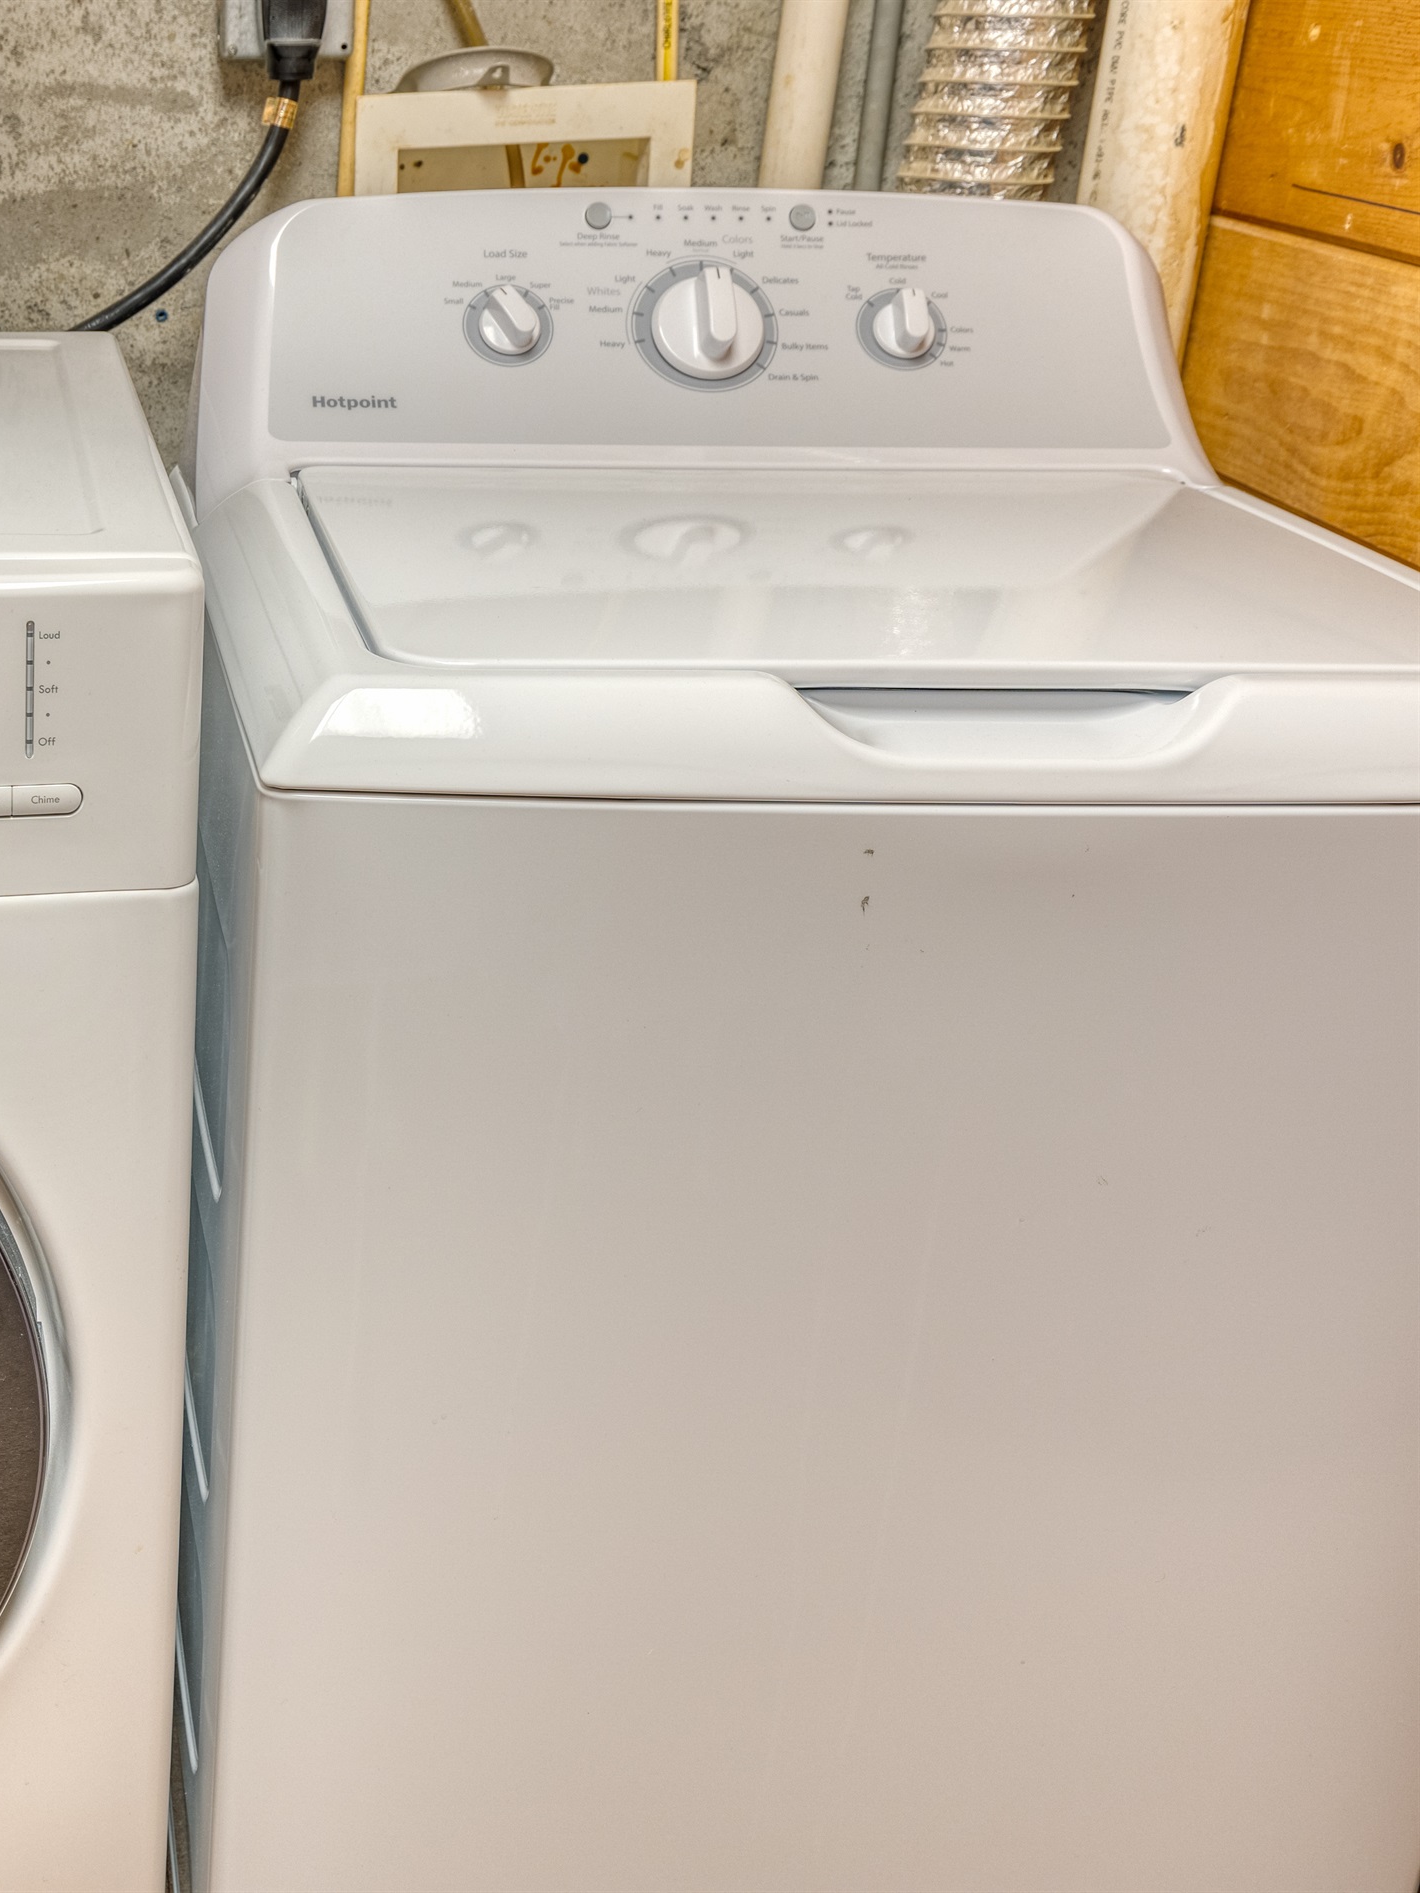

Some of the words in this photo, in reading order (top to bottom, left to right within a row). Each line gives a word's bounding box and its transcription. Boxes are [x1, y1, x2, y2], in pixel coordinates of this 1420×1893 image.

[1113, 31, 1125, 50] PVC
[1104, 79, 1117, 103] PIPE
[704, 204, 722, 212] Wash
[761, 205, 776, 213] Spin
[577, 233, 597, 241] Deep
[722, 235, 753, 244] Colors
[780, 235, 824, 243] Start/Pause
[684, 239, 717, 248] Medium
[484, 250, 507, 259] Load
[509, 250, 528, 259] Size
[646, 249, 672, 258] Heavy
[733, 250, 754, 259] Light
[866, 253, 927, 264] Temperature
[495, 274, 516, 282] Large
[614, 274, 636, 284] Light
[762, 276, 799, 285] Delicates
[889, 277, 907, 285] Cold
[452, 280, 483, 288] Medium
[530, 281, 551, 289] Super
[587, 286, 621, 296] Whites
[847, 285, 861, 293] Tap
[931, 291, 949, 299] Cool
[444, 297, 464, 305] Small
[589, 305, 623, 314] Medium
[779, 308, 810, 317] Casuals
[950, 326, 974, 334] Colors
[599, 340, 626, 349] Heavy
[781, 342, 805, 351] Bulky
[806, 342, 828, 350] Items
[768, 373, 791, 382] Drain
[800, 373, 819, 383] Spin
[311, 395, 398, 411] Hotpoint
[38, 630, 61, 641] Loud
[38, 684, 59, 694] Soft
[38, 736, 56, 747] Off
[30, 794, 60, 805] Chime
